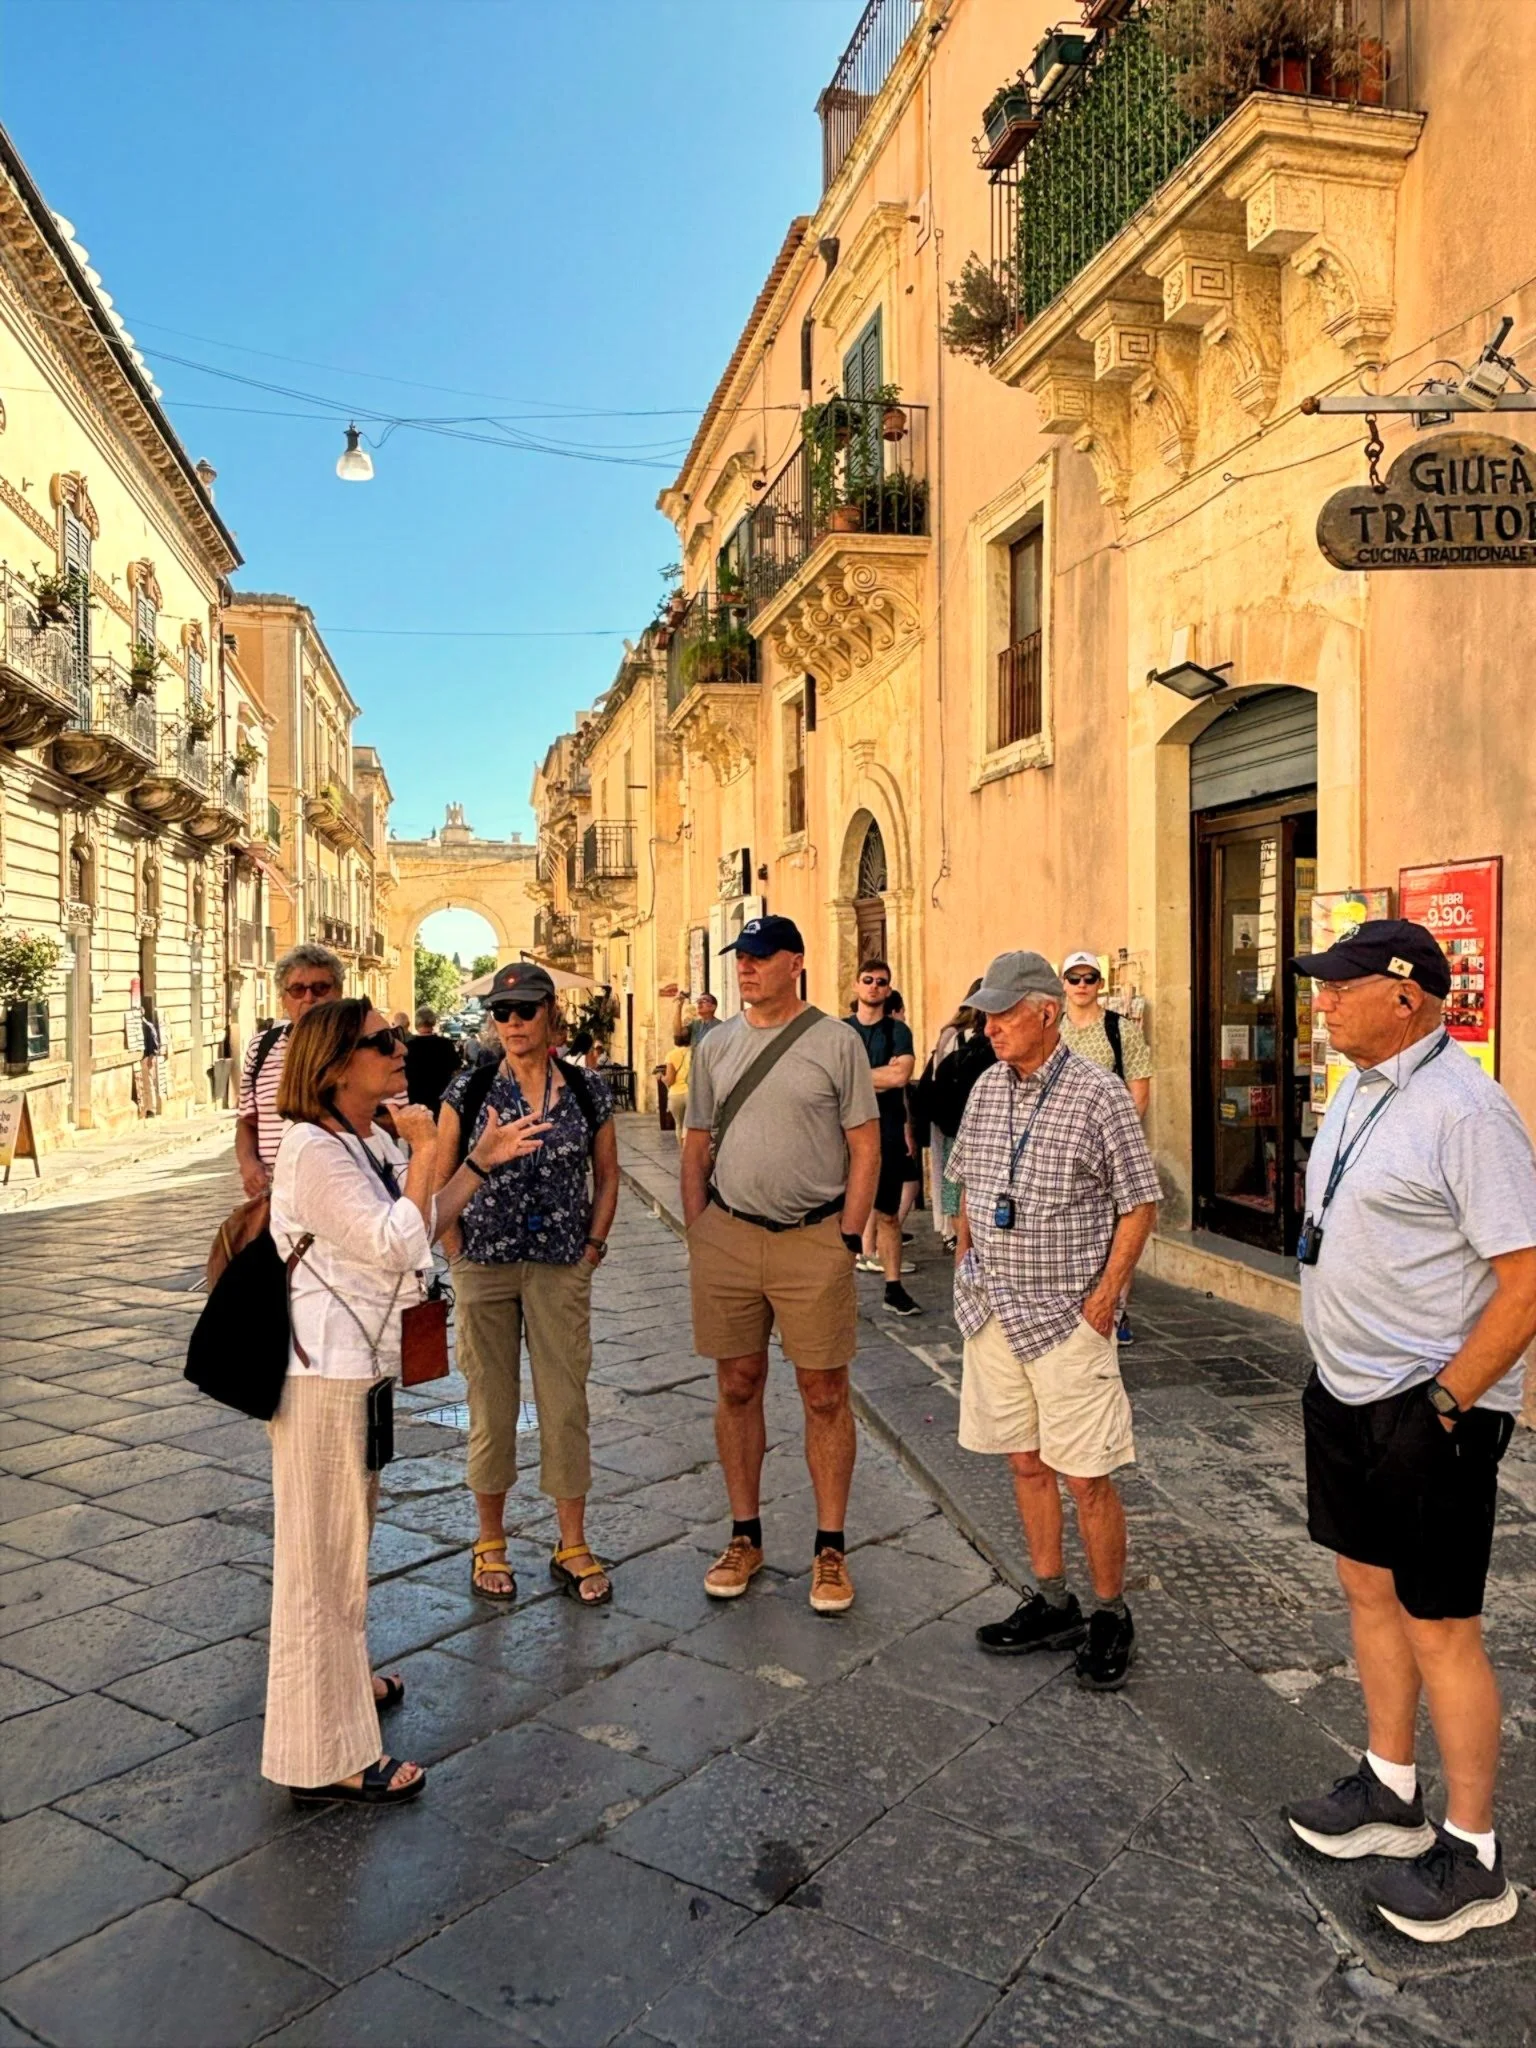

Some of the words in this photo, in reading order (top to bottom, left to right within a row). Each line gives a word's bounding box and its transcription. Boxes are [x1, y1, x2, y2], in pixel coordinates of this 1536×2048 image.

[1409, 444, 1534, 496] GIUFÀ
[1357, 547, 1420, 563] CUCINA
[1421, 545, 1528, 562] TRADIZIONALE
[1438, 892, 1464, 905] LIBRI
